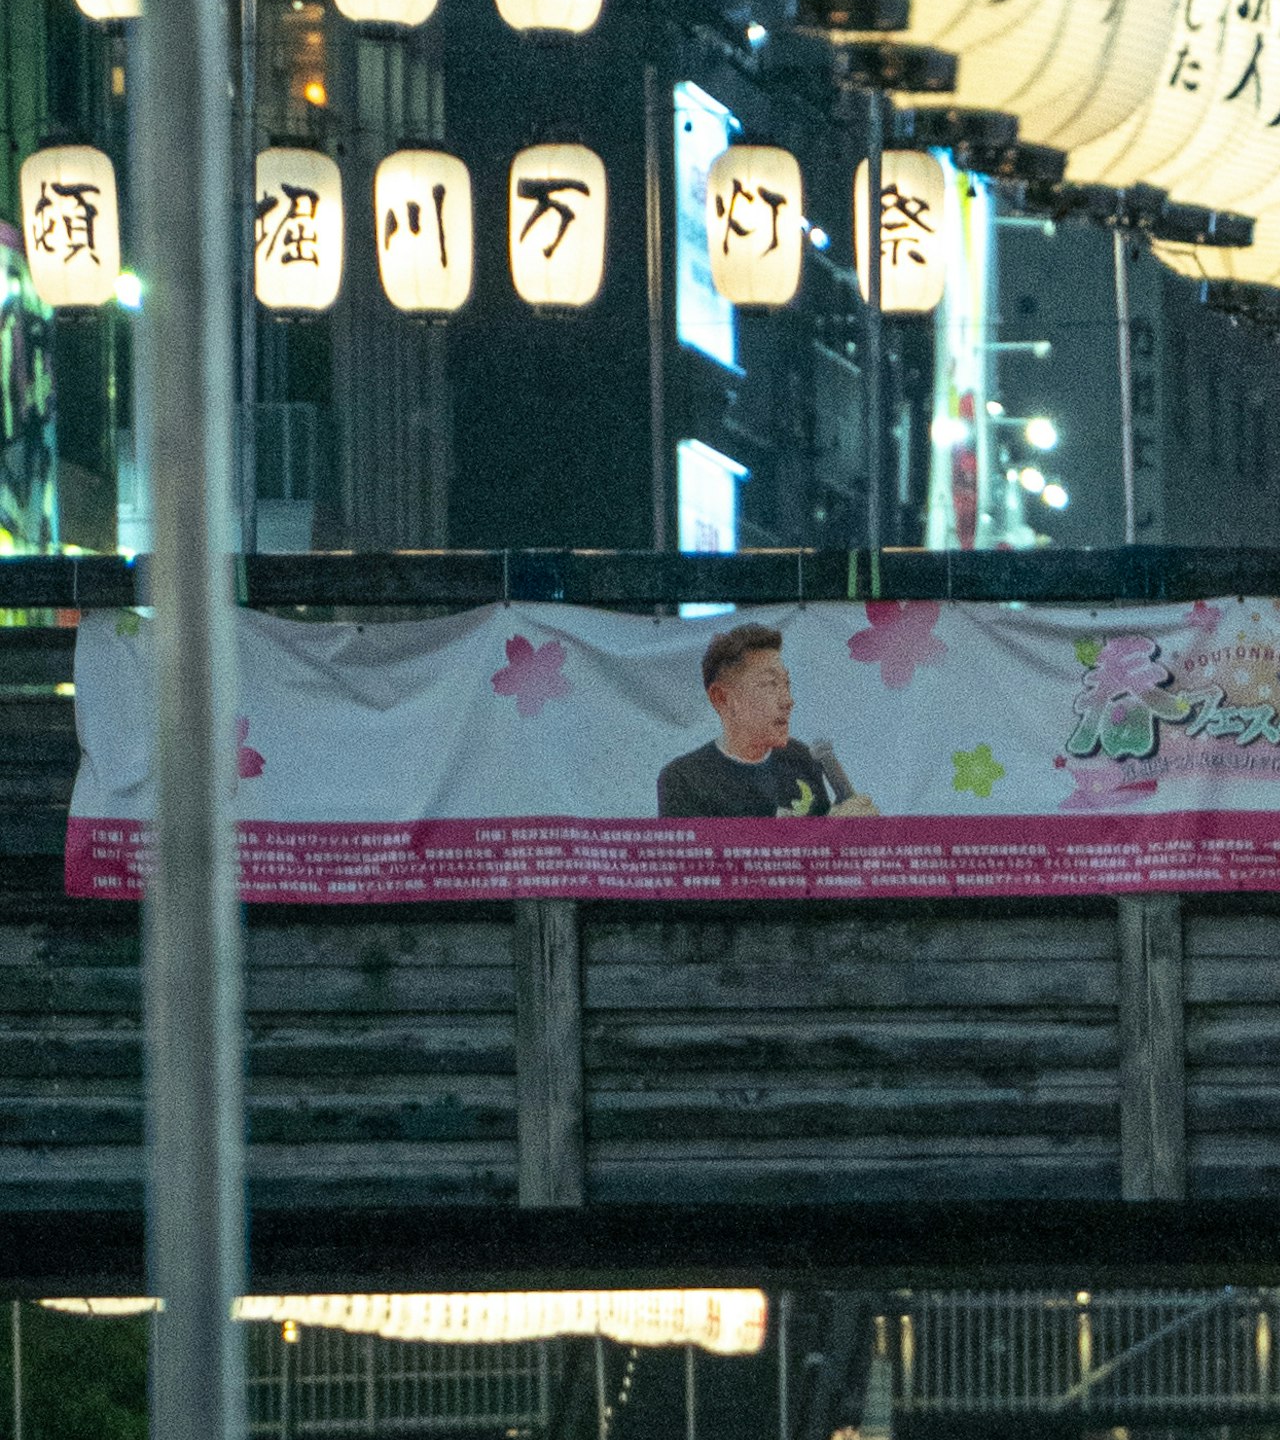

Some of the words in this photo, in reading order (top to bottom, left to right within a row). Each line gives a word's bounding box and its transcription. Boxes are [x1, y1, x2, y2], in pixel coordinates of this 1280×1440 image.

[33, 180, 101, 266] 頓
[257, 184, 321, 267] 堀
[385, 184, 448, 268] 川
[517, 177, 592, 260] 万
[714, 177, 788, 258] 灯
[880, 182, 936, 266] 祭
